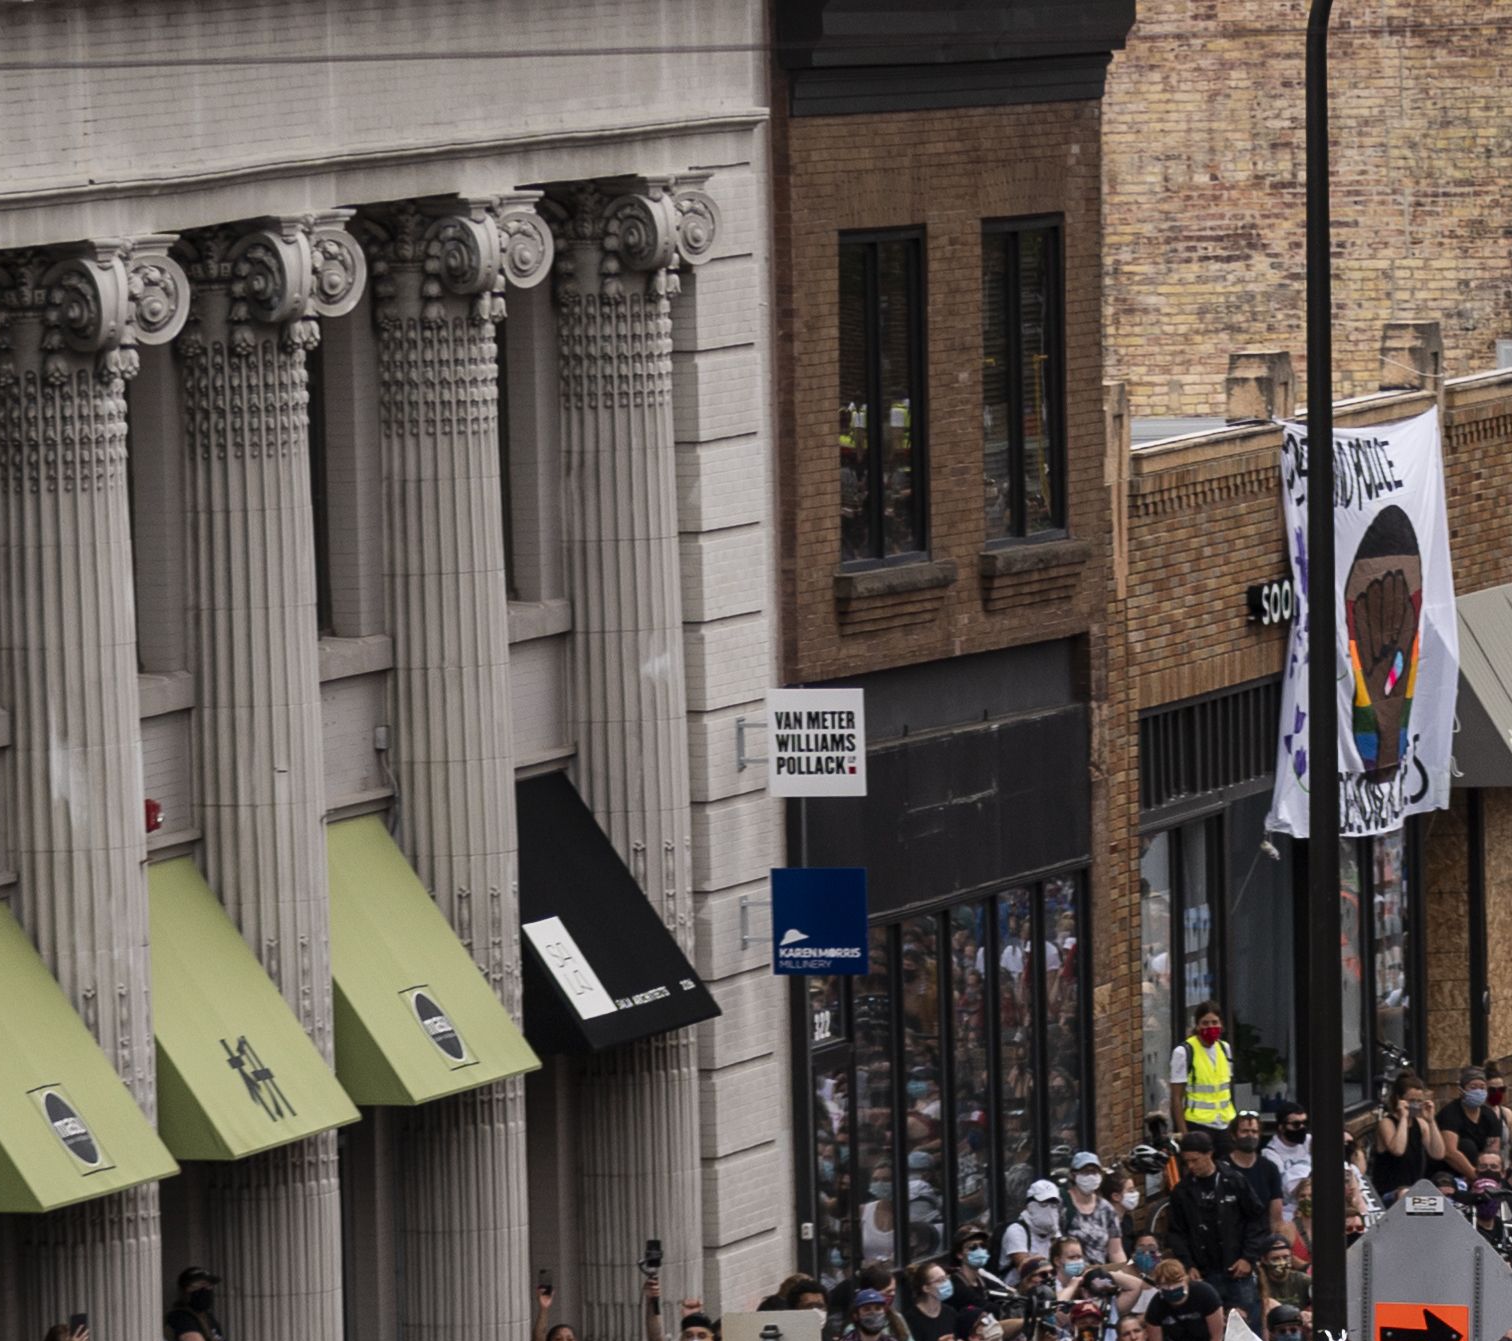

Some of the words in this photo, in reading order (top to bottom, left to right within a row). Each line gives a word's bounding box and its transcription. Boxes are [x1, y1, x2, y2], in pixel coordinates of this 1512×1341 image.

[774, 710, 805, 730] VAN
[806, 710, 856, 730] METER
[775, 733, 856, 753] WILLIAMS
[776, 755, 847, 776] POLLACK
[779, 947, 814, 959] KAREN
[814, 947, 862, 959] MORRIS
[779, 959, 833, 970] MILLINERY
